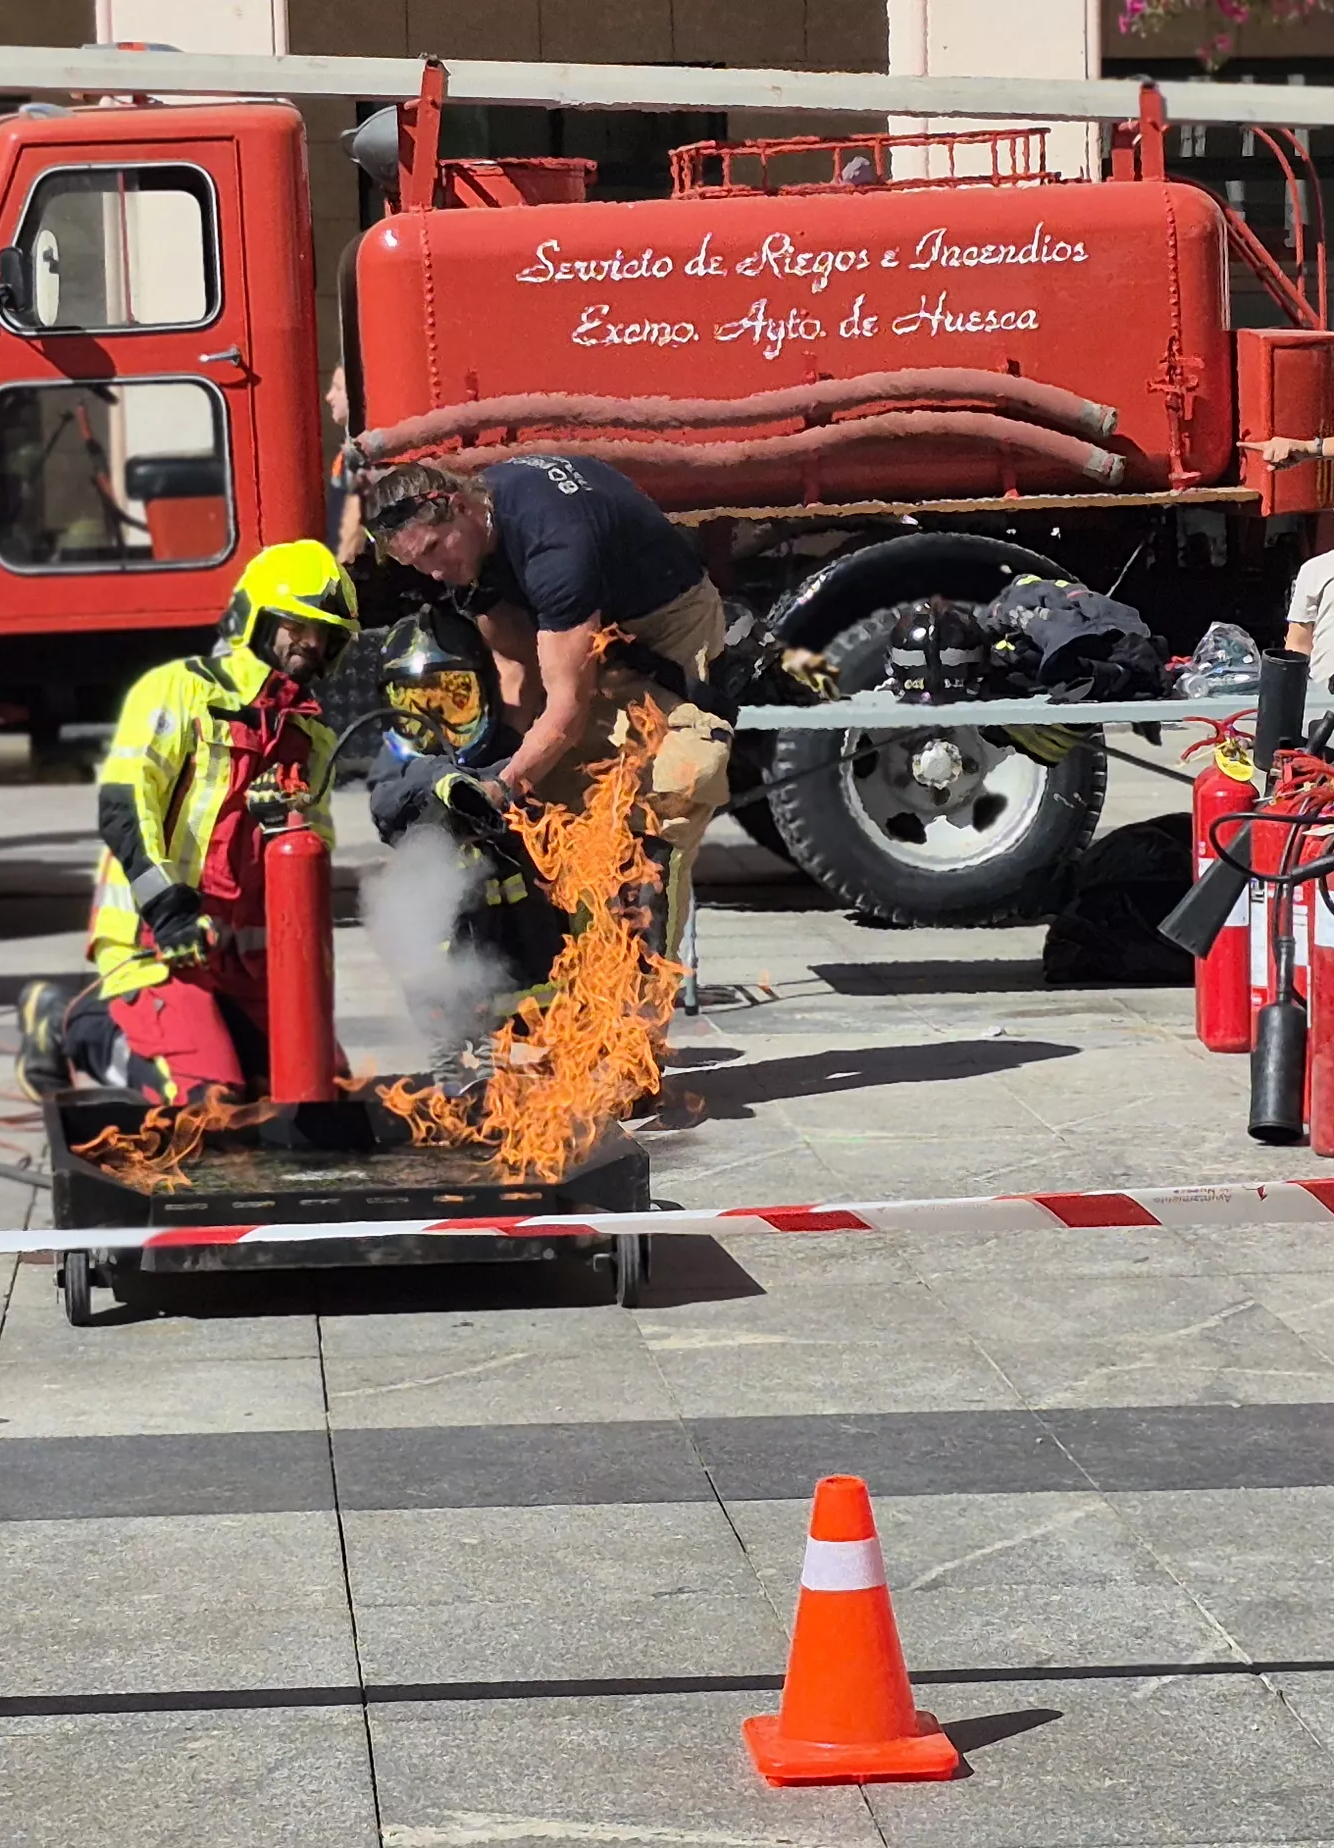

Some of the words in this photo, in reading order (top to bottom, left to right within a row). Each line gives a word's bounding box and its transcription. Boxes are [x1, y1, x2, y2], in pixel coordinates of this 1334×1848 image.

[516, 239, 673, 283] Servicio
[685, 232, 727, 277] de
[736, 232, 870, 293] Riegos
[880, 246, 901, 268] e
[908, 221, 1089, 271] Incendios
[714, 298, 827, 360] Ayto.
[839, 293, 879, 338] de
[891, 290, 1040, 337] Huesca
